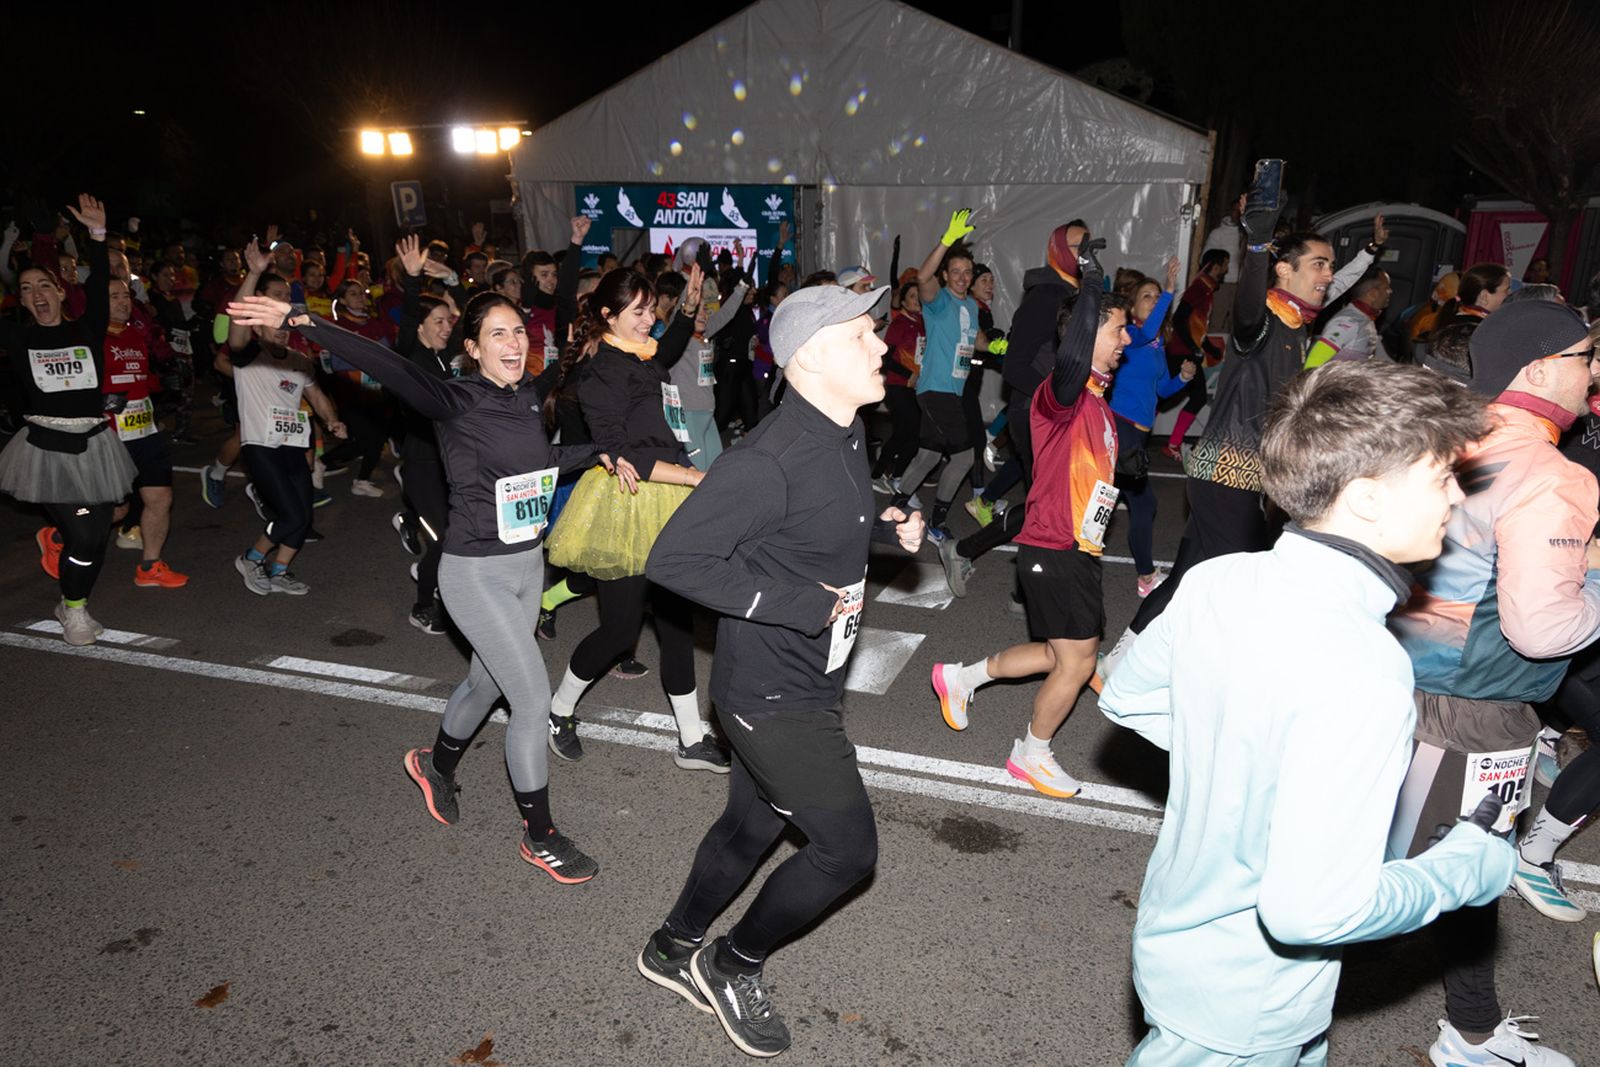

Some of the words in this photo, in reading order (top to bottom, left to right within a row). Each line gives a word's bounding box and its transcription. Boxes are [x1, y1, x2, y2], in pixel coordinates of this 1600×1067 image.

[657, 191, 677, 209] 43
[676, 192, 709, 208] SAN
[653, 205, 707, 225] ANTÓN
[44, 361, 83, 376] 3079
[275, 421, 304, 434] 5505
[506, 493, 518, 501] SAN
[515, 495, 548, 521] 8176
[1094, 505, 1110, 525] 66
[1493, 757, 1524, 770] NOCHE
[1479, 772, 1501, 782] SAN
